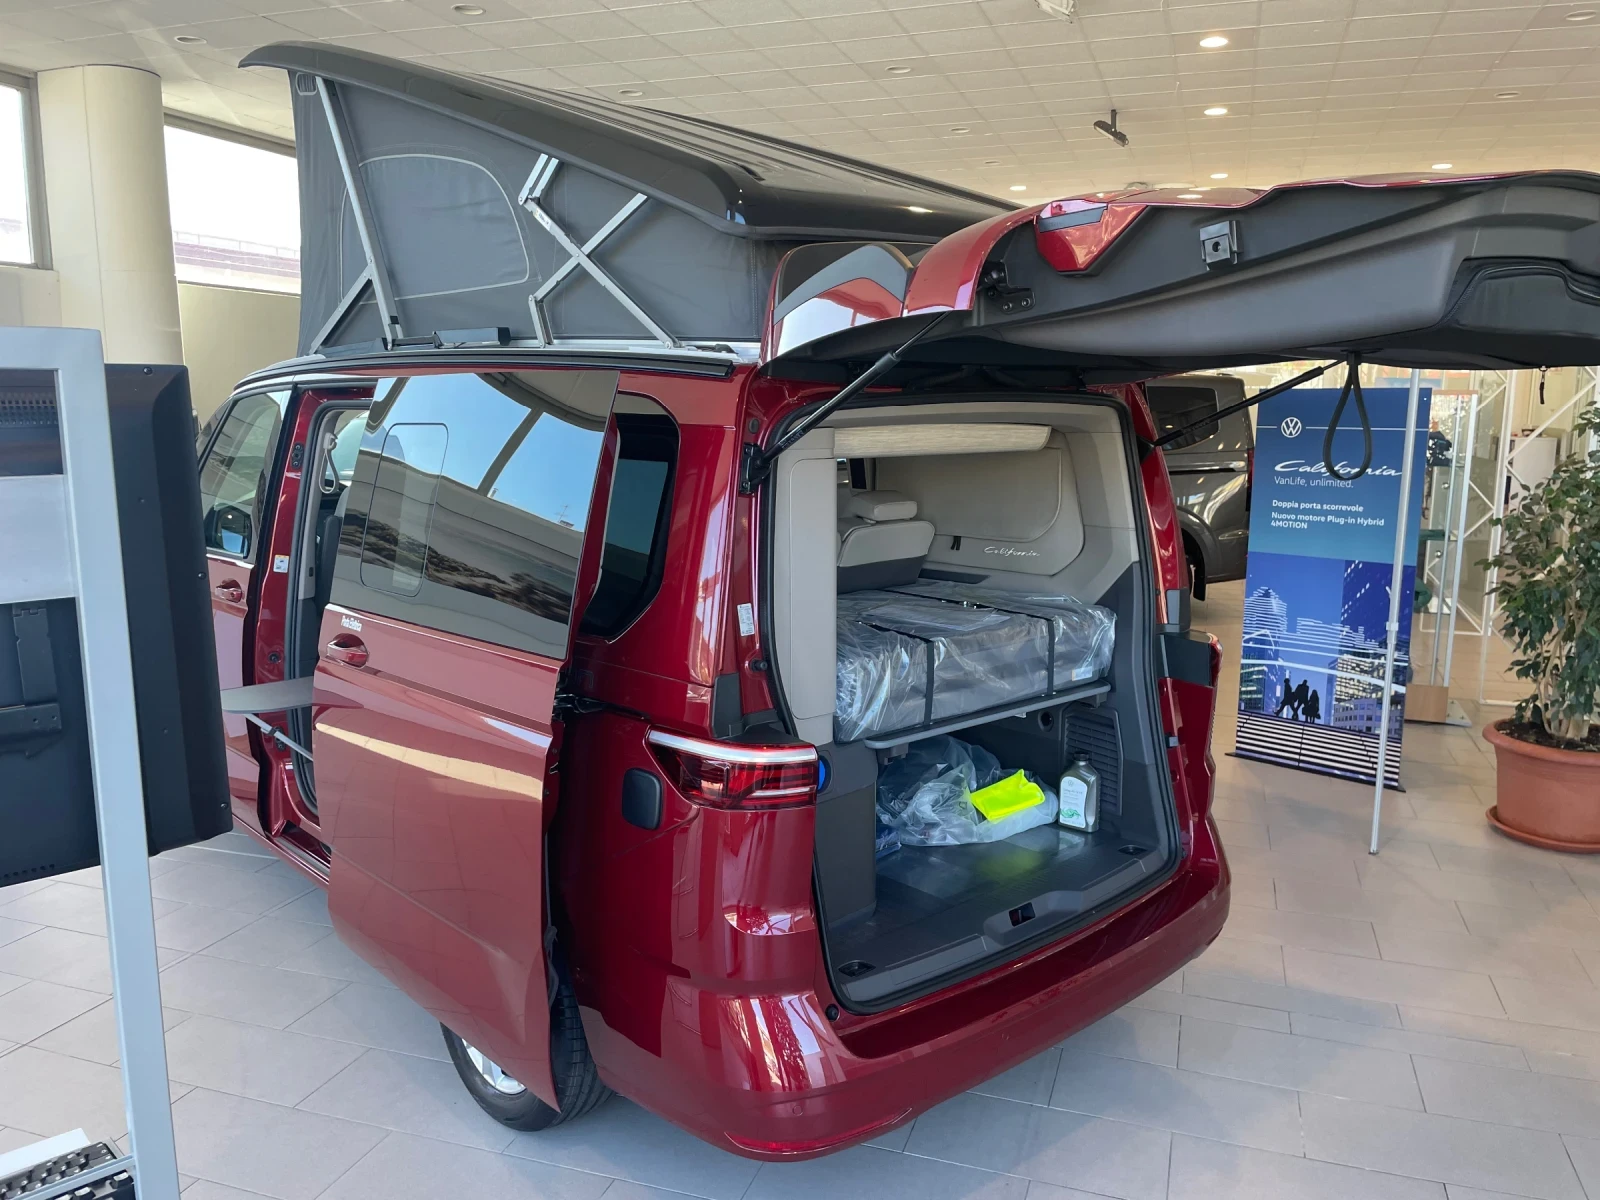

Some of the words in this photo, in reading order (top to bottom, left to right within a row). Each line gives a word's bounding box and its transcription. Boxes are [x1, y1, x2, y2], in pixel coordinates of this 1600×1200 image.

[1274, 476, 1308, 487] VanLife,
[1310, 478, 1354, 488] unlimited.
[1272, 500, 1298, 508] Doppia
[1300, 502, 1321, 510] porta
[1322, 504, 1364, 512] scorrevole
[1271, 512, 1296, 520] Nuovo
[1297, 514, 1326, 522] motore
[1327, 515, 1356, 525] Plug-in
[1357, 518, 1385, 527] Hybrid
[1271, 521, 1308, 529] 4MOTION
[984, 546, 1040, 556] California
